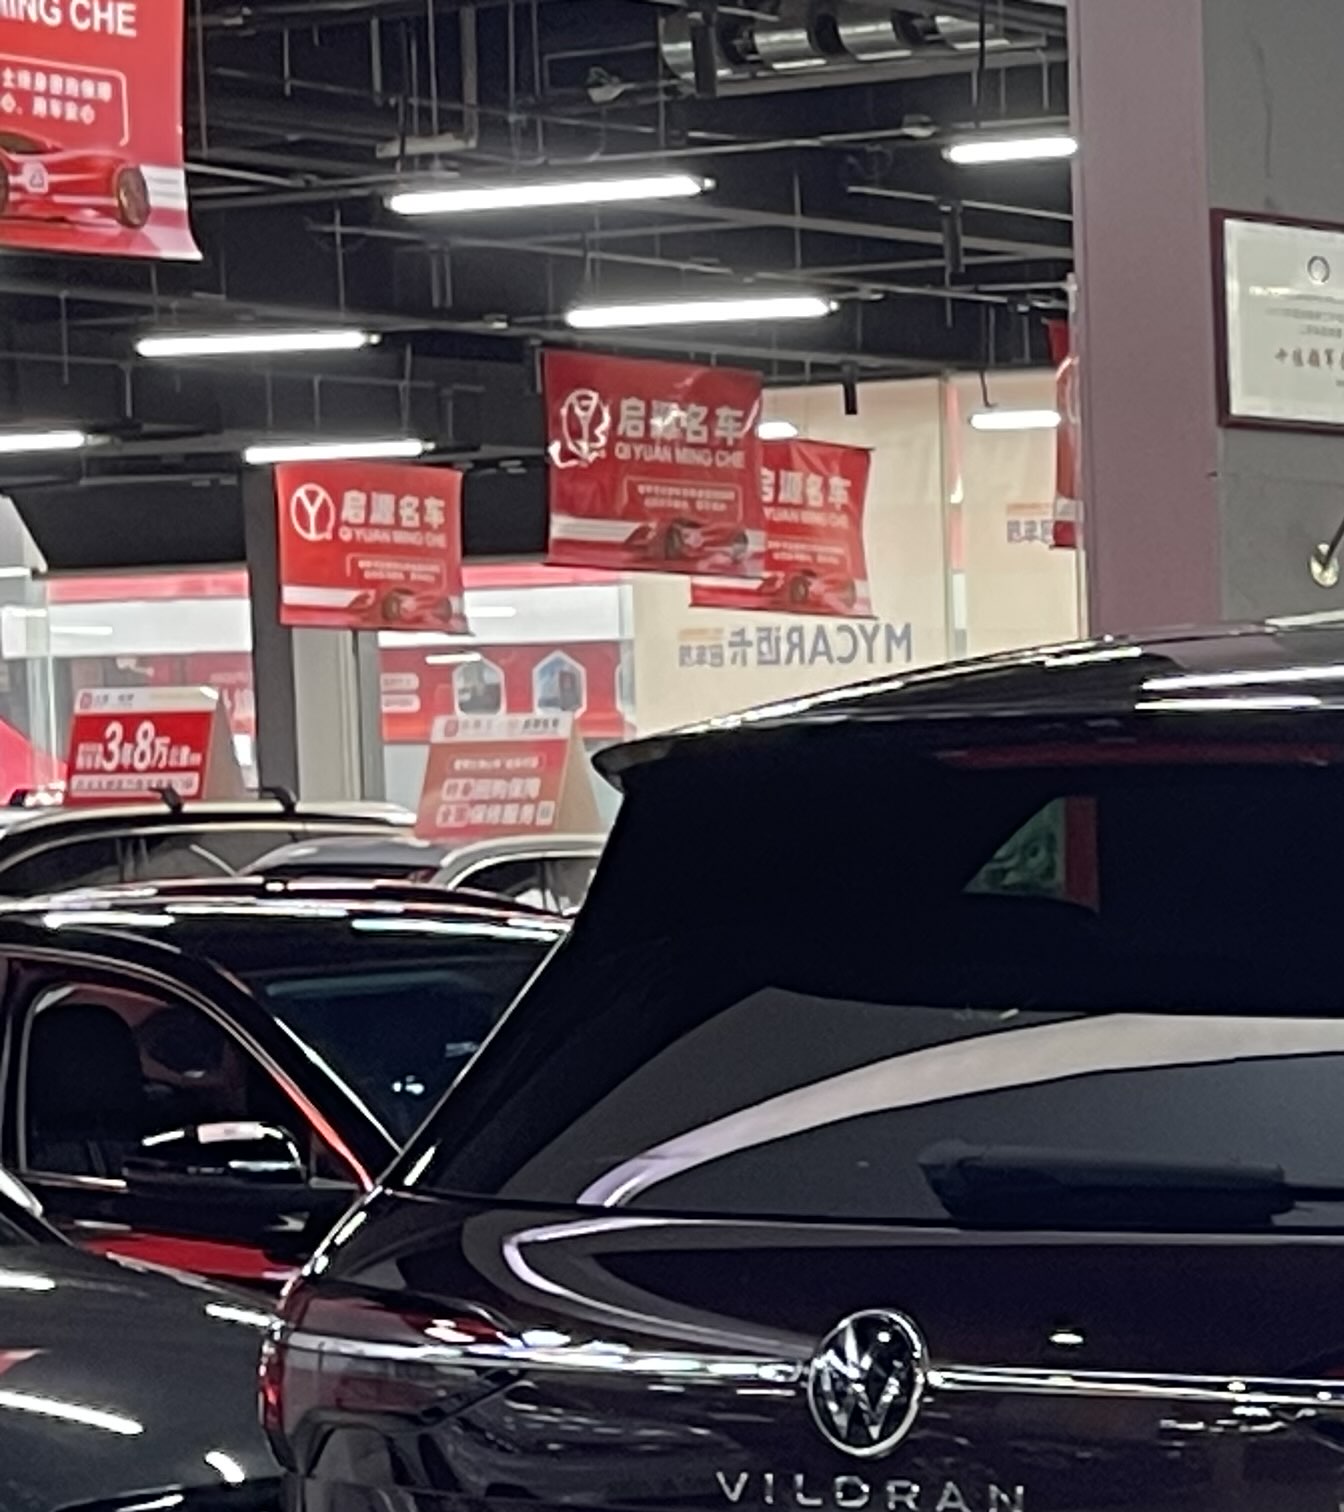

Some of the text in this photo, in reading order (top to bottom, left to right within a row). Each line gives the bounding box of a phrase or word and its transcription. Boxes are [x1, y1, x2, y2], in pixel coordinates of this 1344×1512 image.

[0, 0, 137, 38] ING CHE
[341, 489, 446, 529] 启源名车
